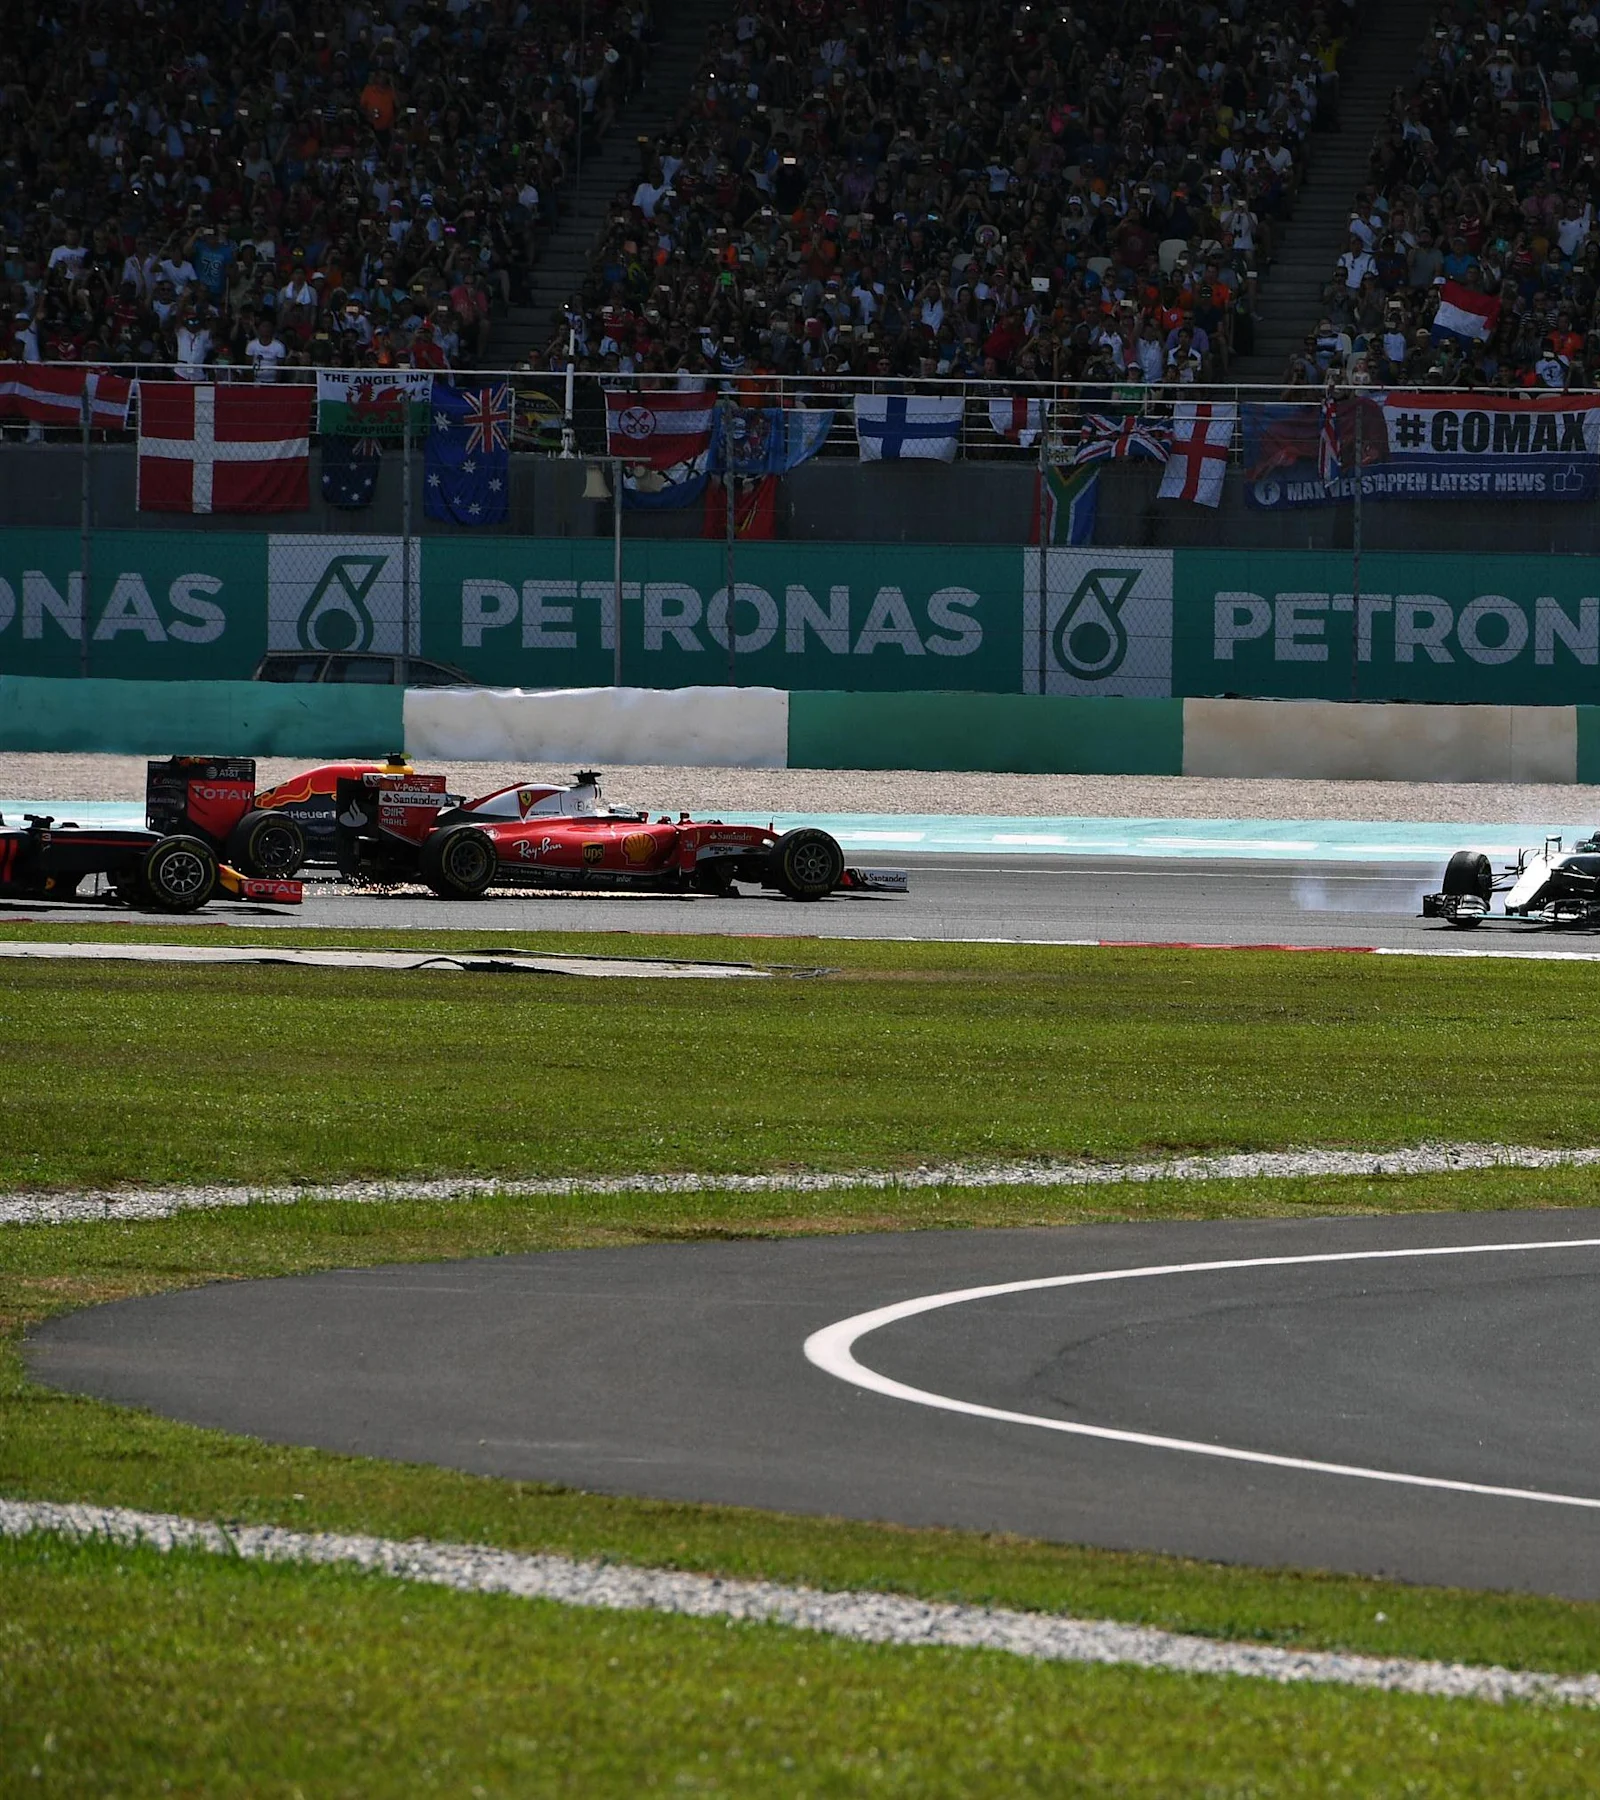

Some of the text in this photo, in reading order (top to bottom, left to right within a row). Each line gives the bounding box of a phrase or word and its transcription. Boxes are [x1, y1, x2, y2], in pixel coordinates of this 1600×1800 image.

[324, 374, 429, 385] THE ANGEL INN
[1396, 411, 1587, 453] #GOMAX
[1431, 473, 1492, 492] LATEST
[1496, 472, 1546, 492] NEWS
[0, 570, 226, 643] NAS
[461, 579, 983, 656] PETRONAS
[219, 769, 239, 778] AT&T
[192, 785, 253, 800] TOTAL
[393, 793, 439, 805] Santander
[381, 818, 408, 827] MAHLE
[716, 831, 753, 842] Santander
[512, 837, 563, 860] Ray-Ban
[584, 848, 603, 862] ups
[616, 875, 632, 883] infor
[869, 873, 906, 883] Santander
[241, 880, 301, 894] TOTAL
